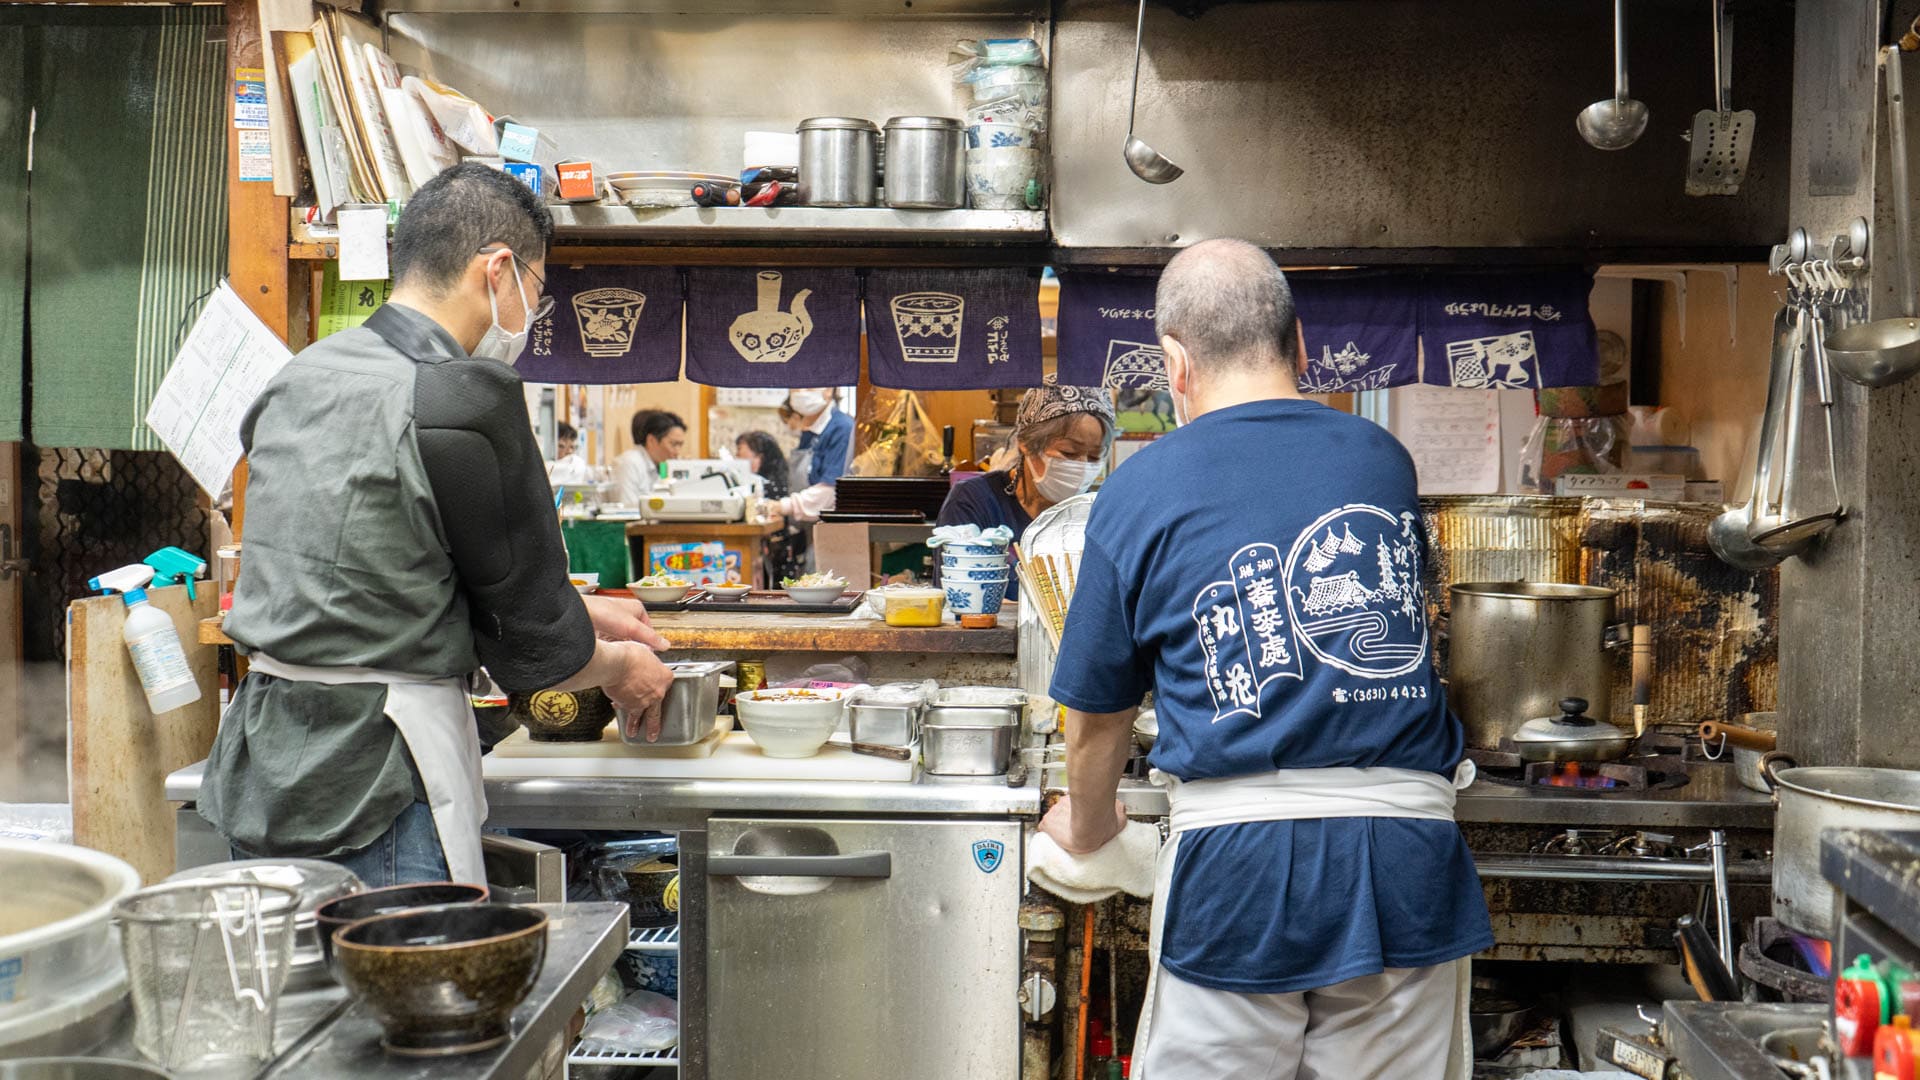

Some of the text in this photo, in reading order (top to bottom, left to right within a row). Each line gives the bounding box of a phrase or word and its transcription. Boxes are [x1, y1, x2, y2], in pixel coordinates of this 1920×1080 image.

[1444, 302, 1531, 318] ヒゲタしょうゆ
[1211, 604, 1256, 707] 丸花
[1390, 685, 1427, 700] 4423
